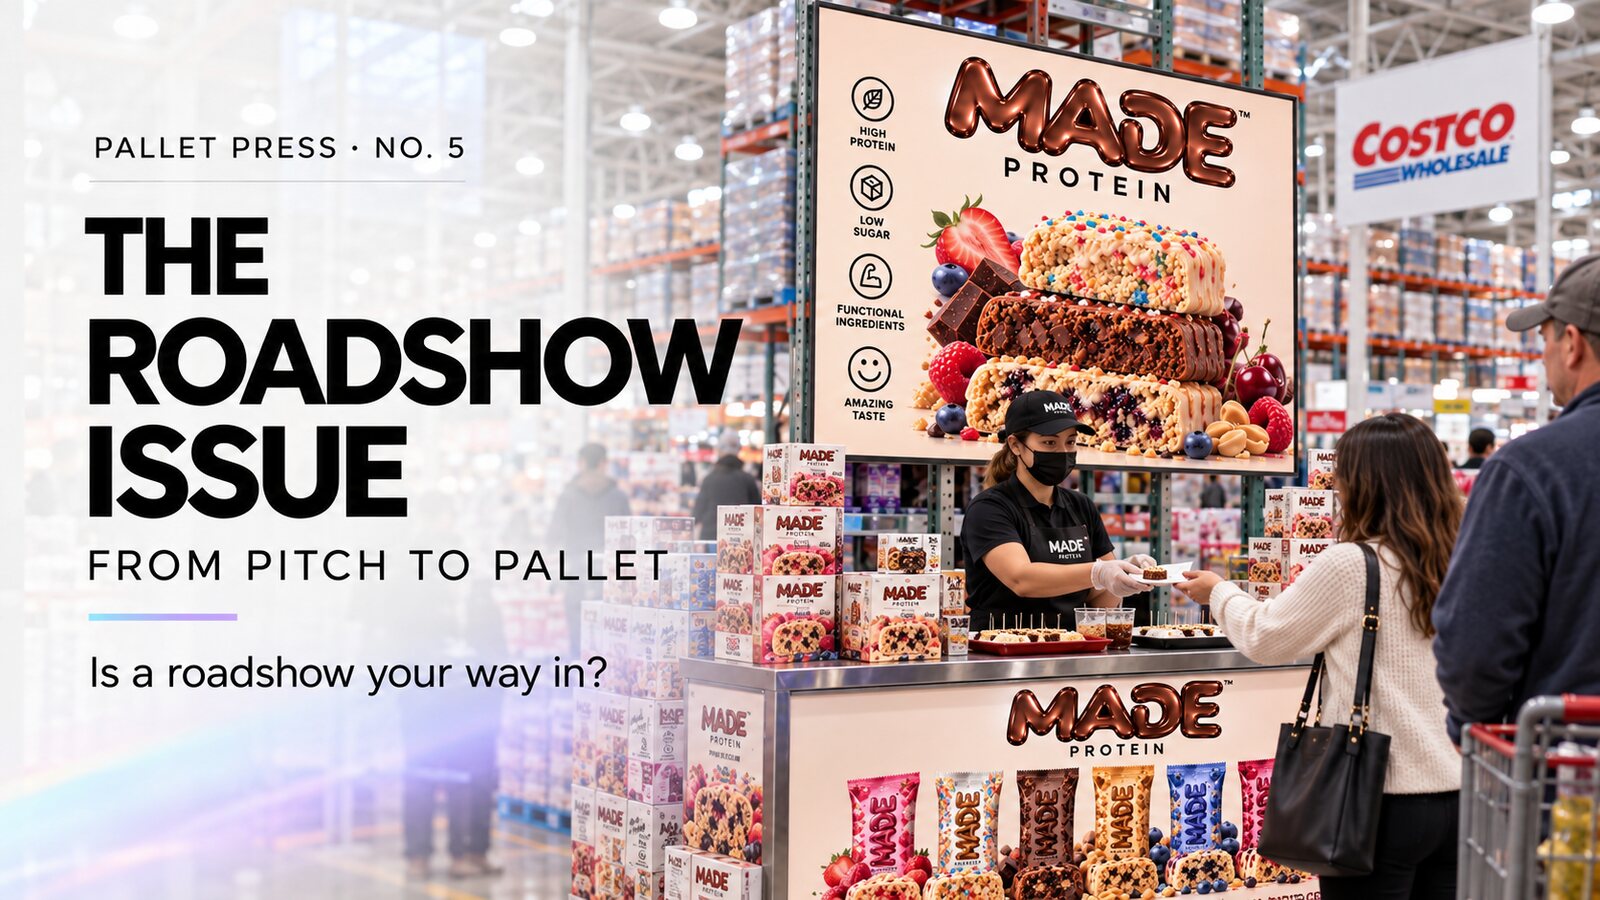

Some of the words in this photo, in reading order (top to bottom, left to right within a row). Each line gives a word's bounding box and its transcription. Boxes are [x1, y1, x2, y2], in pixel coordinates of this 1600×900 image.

[944, 56, 1237, 188] MADE
[860, 126, 886, 138] HIGH
[1353, 102, 1515, 167] COSTCO
[850, 137, 895, 151] PROTEIN
[1401, 145, 1510, 181] WHOLESALE
[1004, 156, 1171, 203] PROTEIN
[860, 216, 884, 227] LOW
[854, 227, 890, 240] SUGAR
[837, 304, 904, 319] FUNCTIONAL
[836, 317, 905, 331] INGREDIENTS
[844, 398, 893, 409] AMAZING
[852, 410, 885, 421] TASTE
[800, 449, 835, 462] MADE
[1299, 496, 1325, 507] MADE
[776, 515, 824, 531] MADE
[1049, 539, 1085, 553] MADE
[776, 582, 823, 598] MADE
[883, 585, 928, 601] MADE
[701, 705, 747, 737] MADE
[1006, 680, 1223, 746] MADE
[709, 735, 741, 749] PROTEIN
[1070, 743, 1164, 757] PROTEIN
[597, 806, 624, 827] MADE
[1110, 785, 1134, 849] MADE
[1184, 782, 1208, 845] MADE
[869, 795, 897, 867] MADE
[954, 791, 981, 860] MADE
[1034, 790, 1058, 856] MADE
[695, 865, 729, 891] MADE
